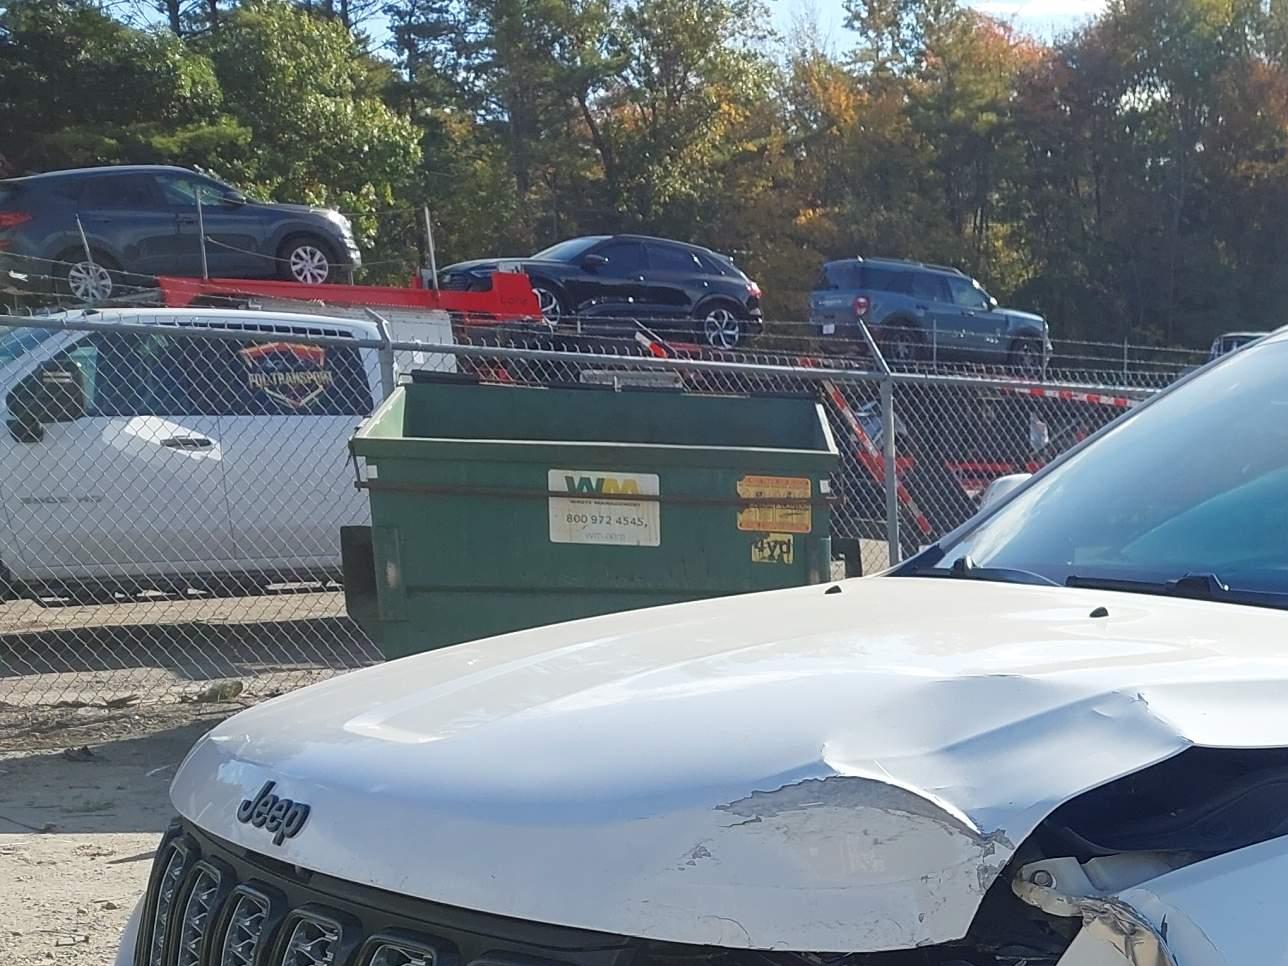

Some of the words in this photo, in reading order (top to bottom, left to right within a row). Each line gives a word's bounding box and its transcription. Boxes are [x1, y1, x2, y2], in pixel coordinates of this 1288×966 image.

[566, 513, 588, 524] 800
[591, 515, 612, 525] 972
[237, 779, 312, 847] Jeep
